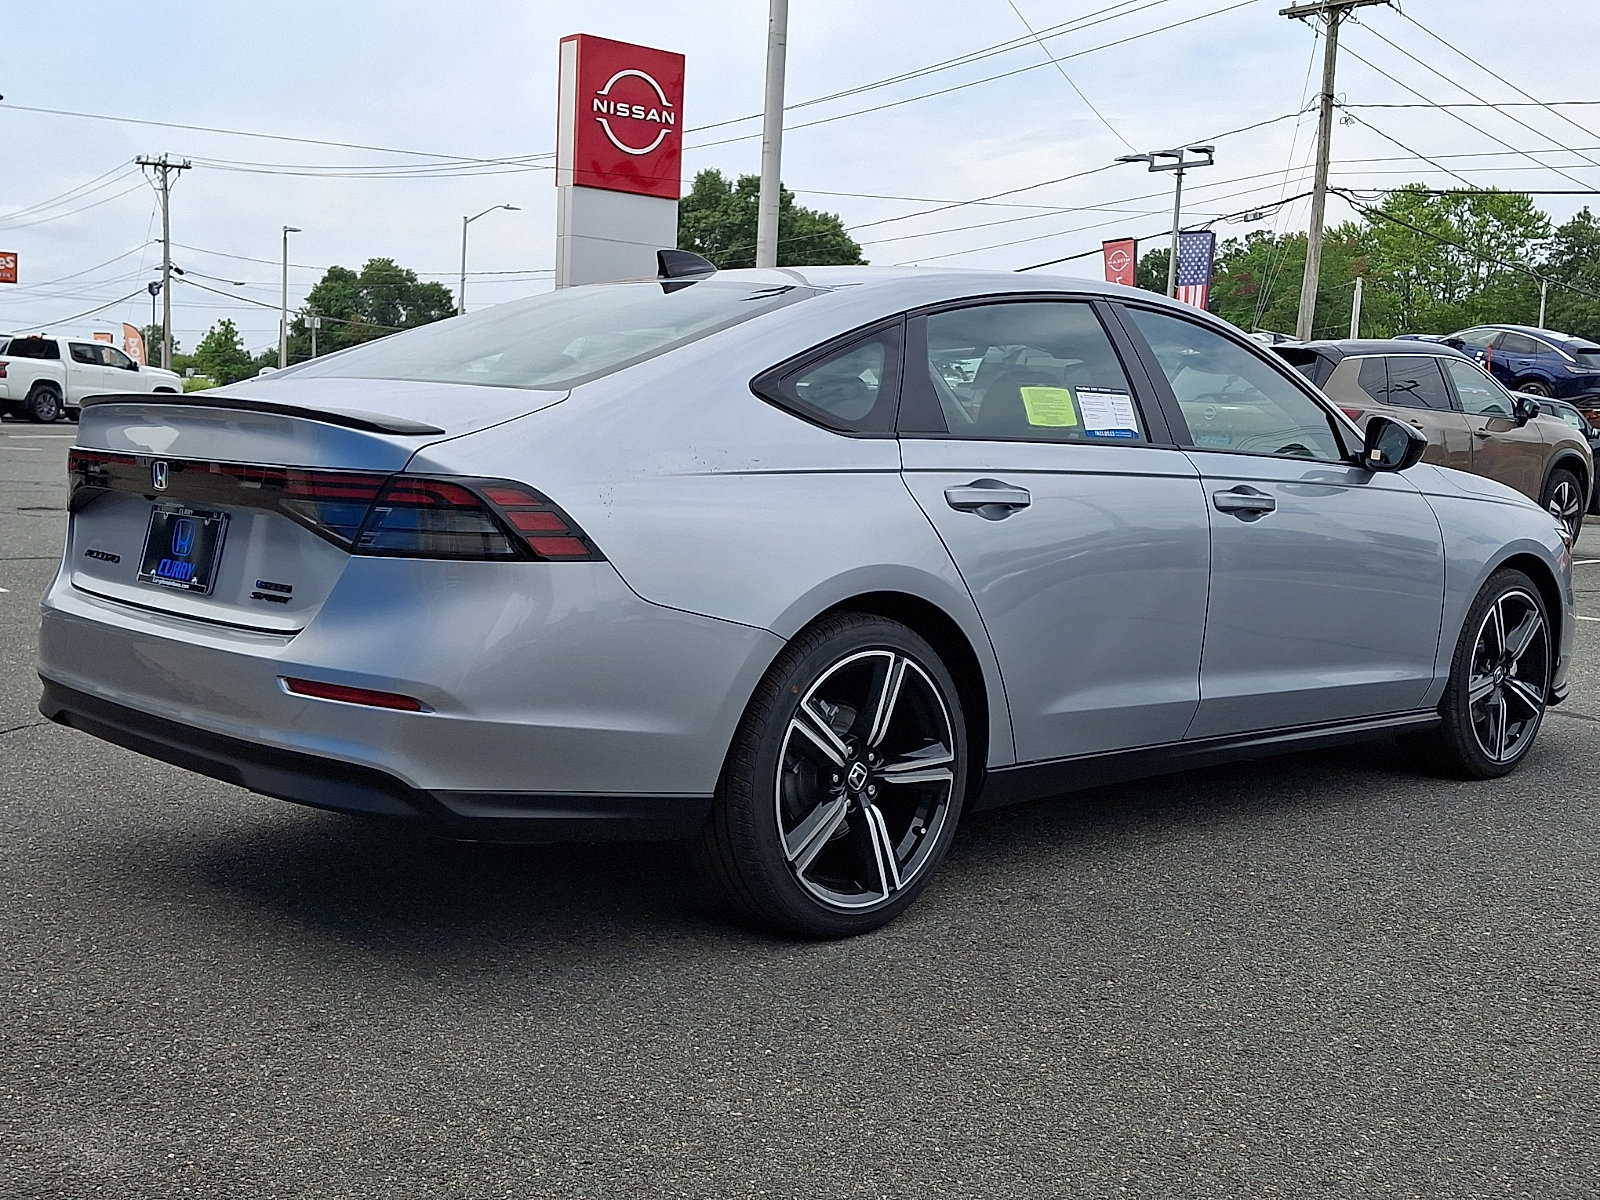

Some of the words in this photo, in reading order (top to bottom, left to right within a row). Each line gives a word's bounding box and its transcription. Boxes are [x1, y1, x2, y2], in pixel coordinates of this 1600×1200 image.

[593, 98, 675, 125] NISSAN
[84, 549, 121, 564] ACCORD
[157, 558, 195, 581] CURRY
